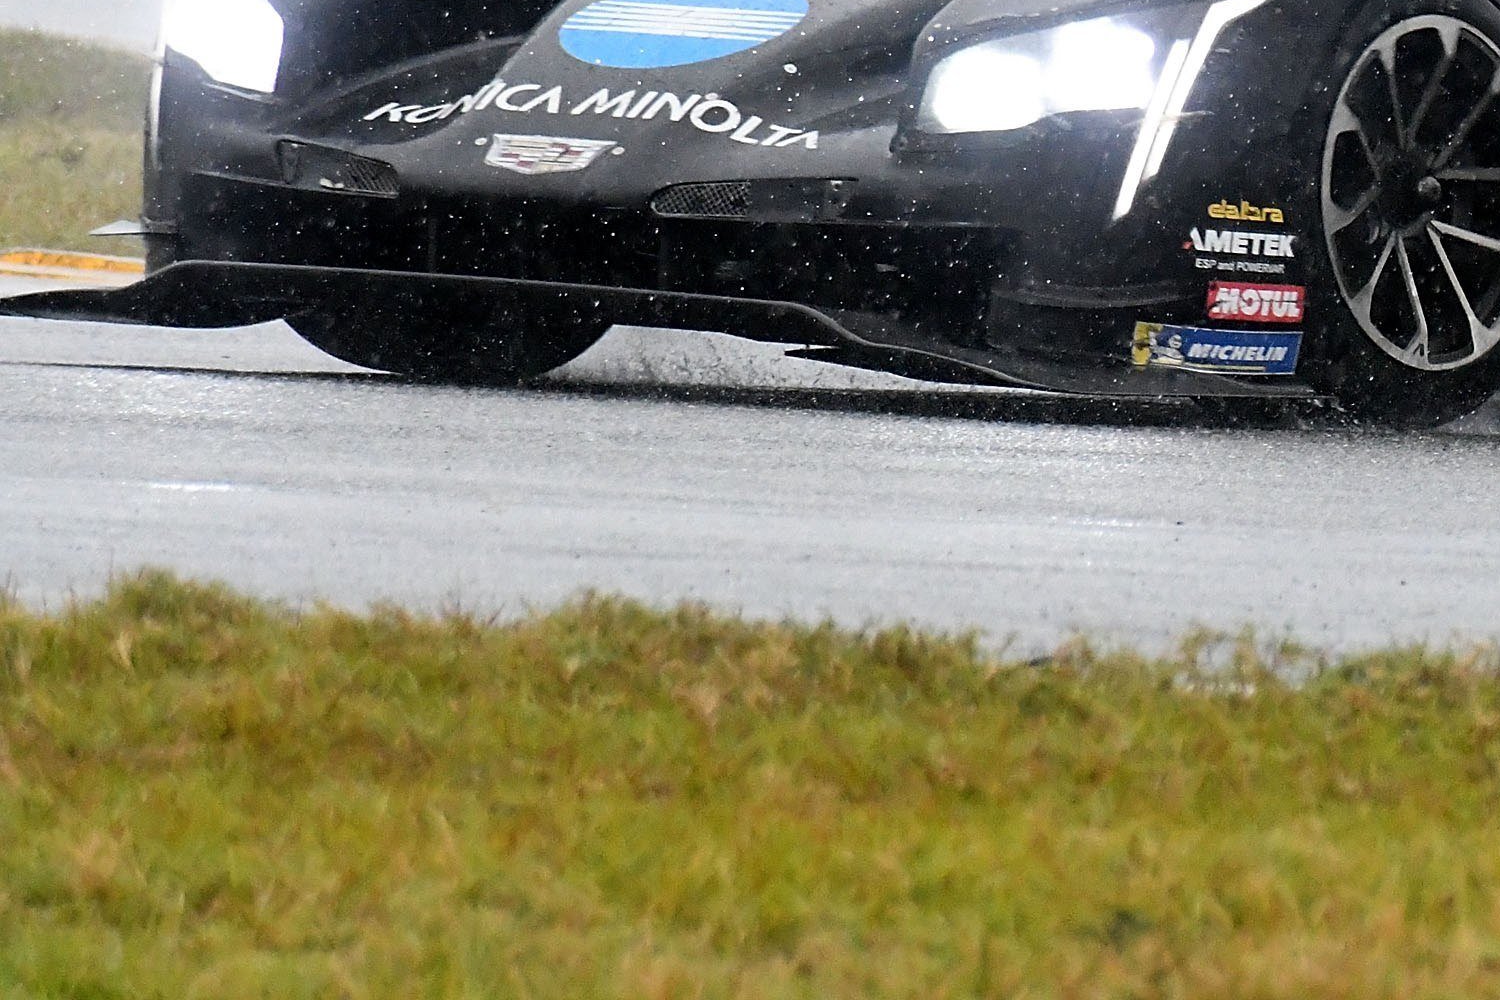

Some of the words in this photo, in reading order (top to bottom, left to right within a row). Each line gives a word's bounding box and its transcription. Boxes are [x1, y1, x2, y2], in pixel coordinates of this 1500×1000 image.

[363, 78, 562, 125] KONICA
[570, 87, 818, 150] MINOLTA
[1182, 227, 1296, 258] AMETEK
[1212, 288, 1300, 317] MOTUL
[1187, 344, 1288, 361] MICHELIN
